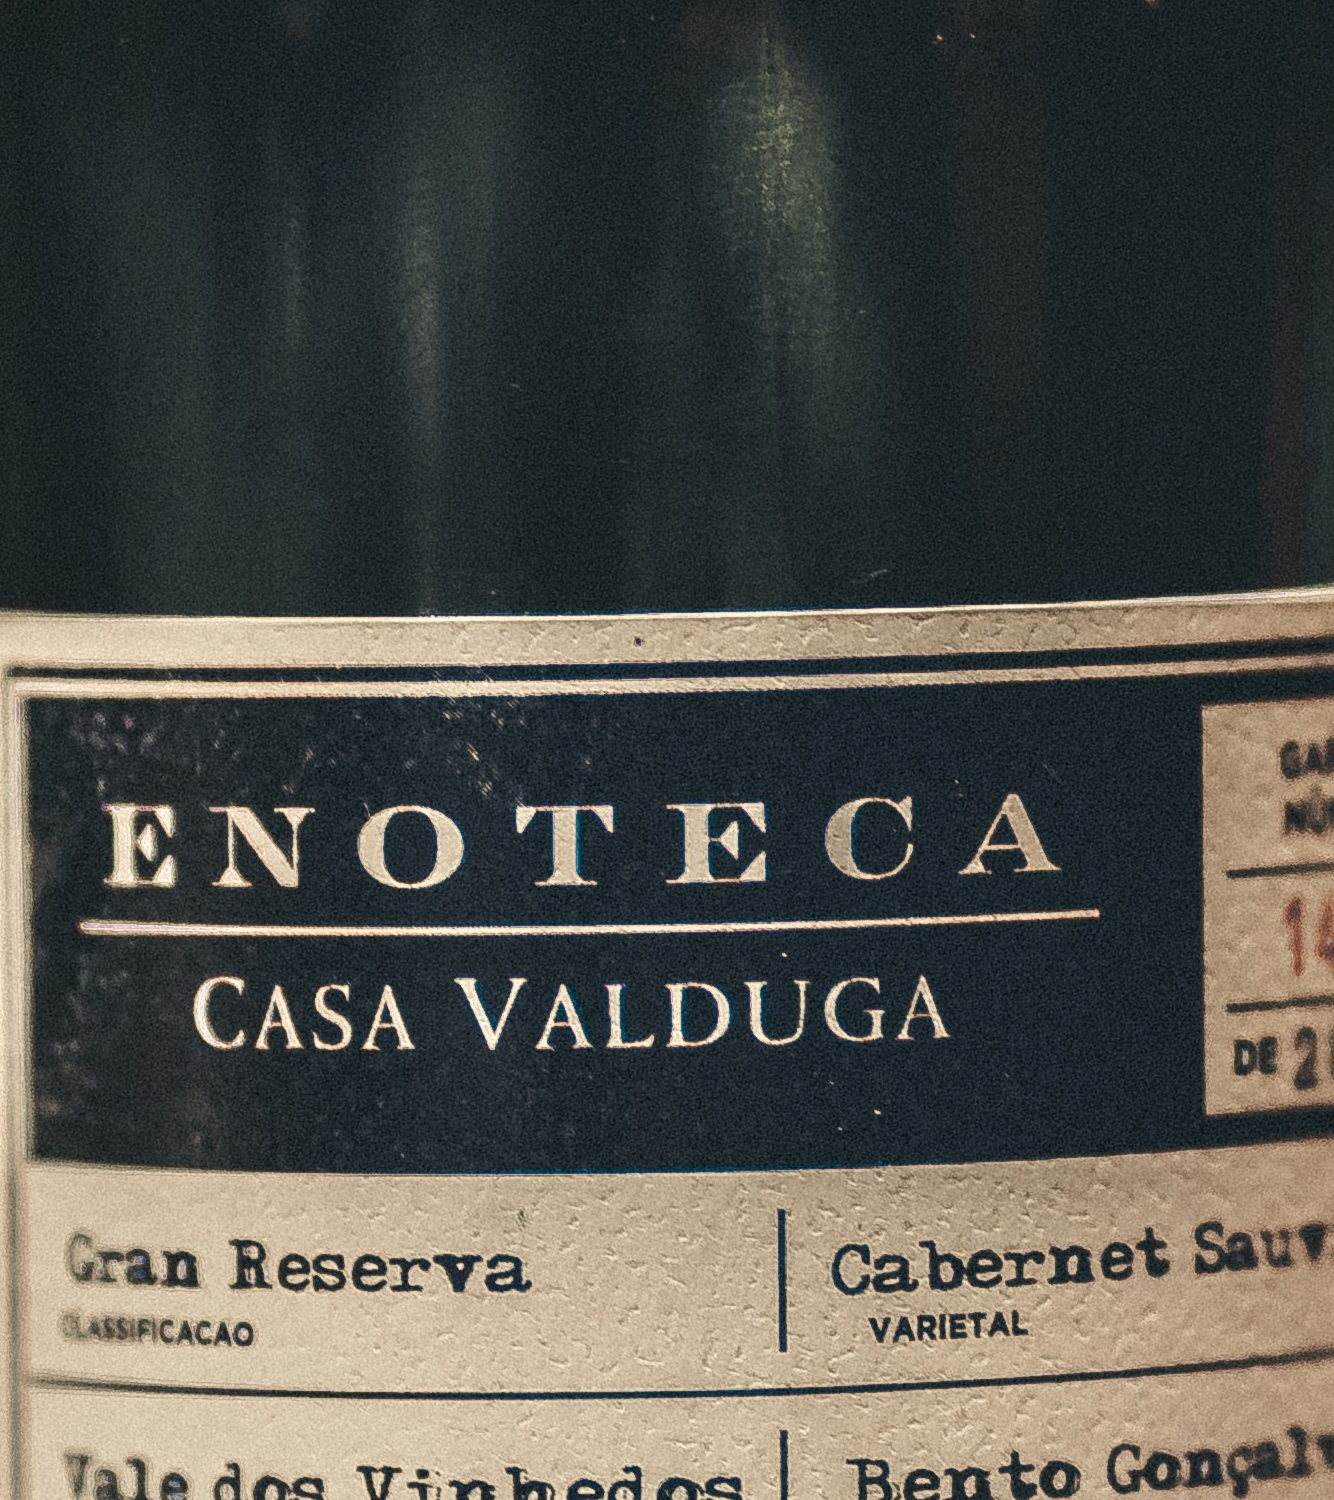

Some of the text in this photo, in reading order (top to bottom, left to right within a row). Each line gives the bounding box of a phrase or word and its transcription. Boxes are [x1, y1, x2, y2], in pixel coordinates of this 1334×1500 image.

[102, 792, 1061, 891] ENOTECA
[191, 974, 951, 1052] CASA VALDUGA
[1231, 1034, 1280, 1078] DE
[67, 1231, 534, 1295] Gran Reserva
[830, 1225, 1172, 1298] Cabernet
[867, 1308, 1030, 1345] VARIETAL
